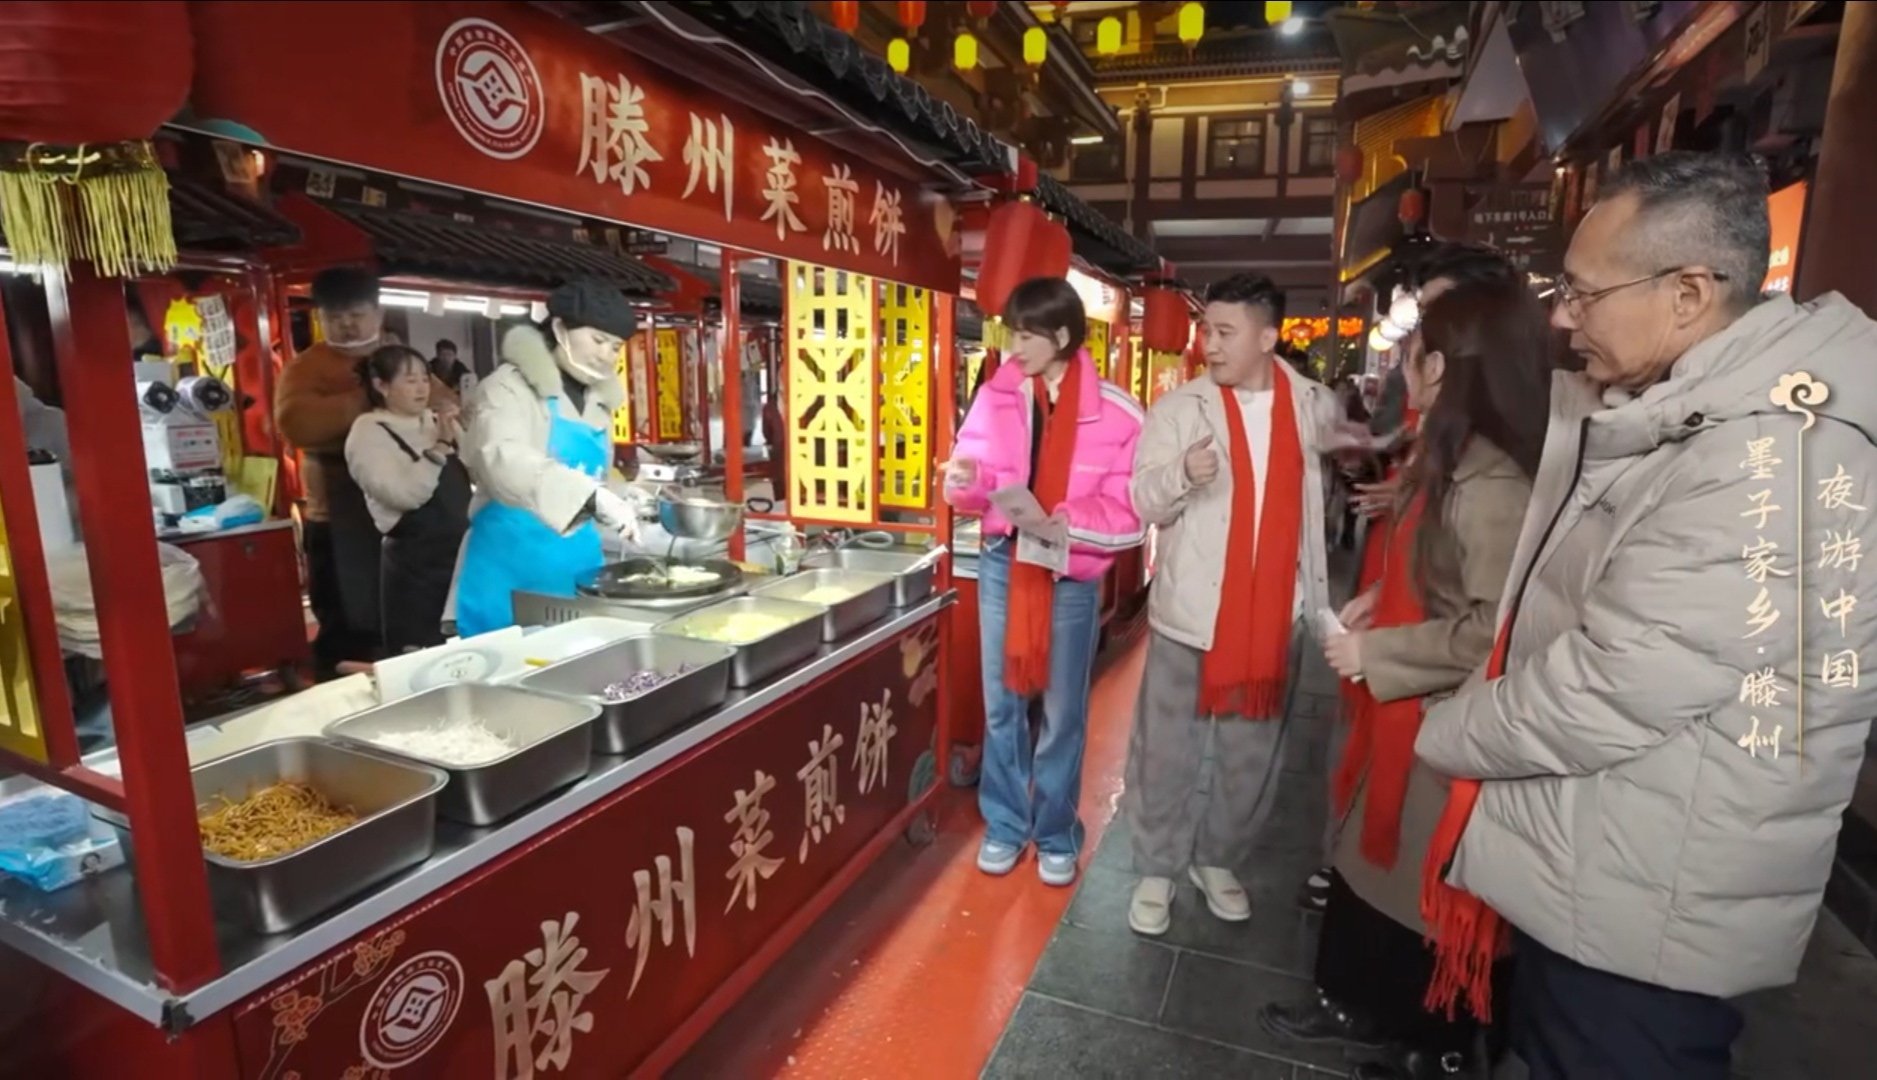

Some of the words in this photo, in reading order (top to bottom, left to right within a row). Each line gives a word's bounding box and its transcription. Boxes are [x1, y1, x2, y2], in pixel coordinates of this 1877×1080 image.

[576, 72, 906, 267] 滕州菜煎饼
[484, 688, 897, 1080] 滕州菜煎饼
